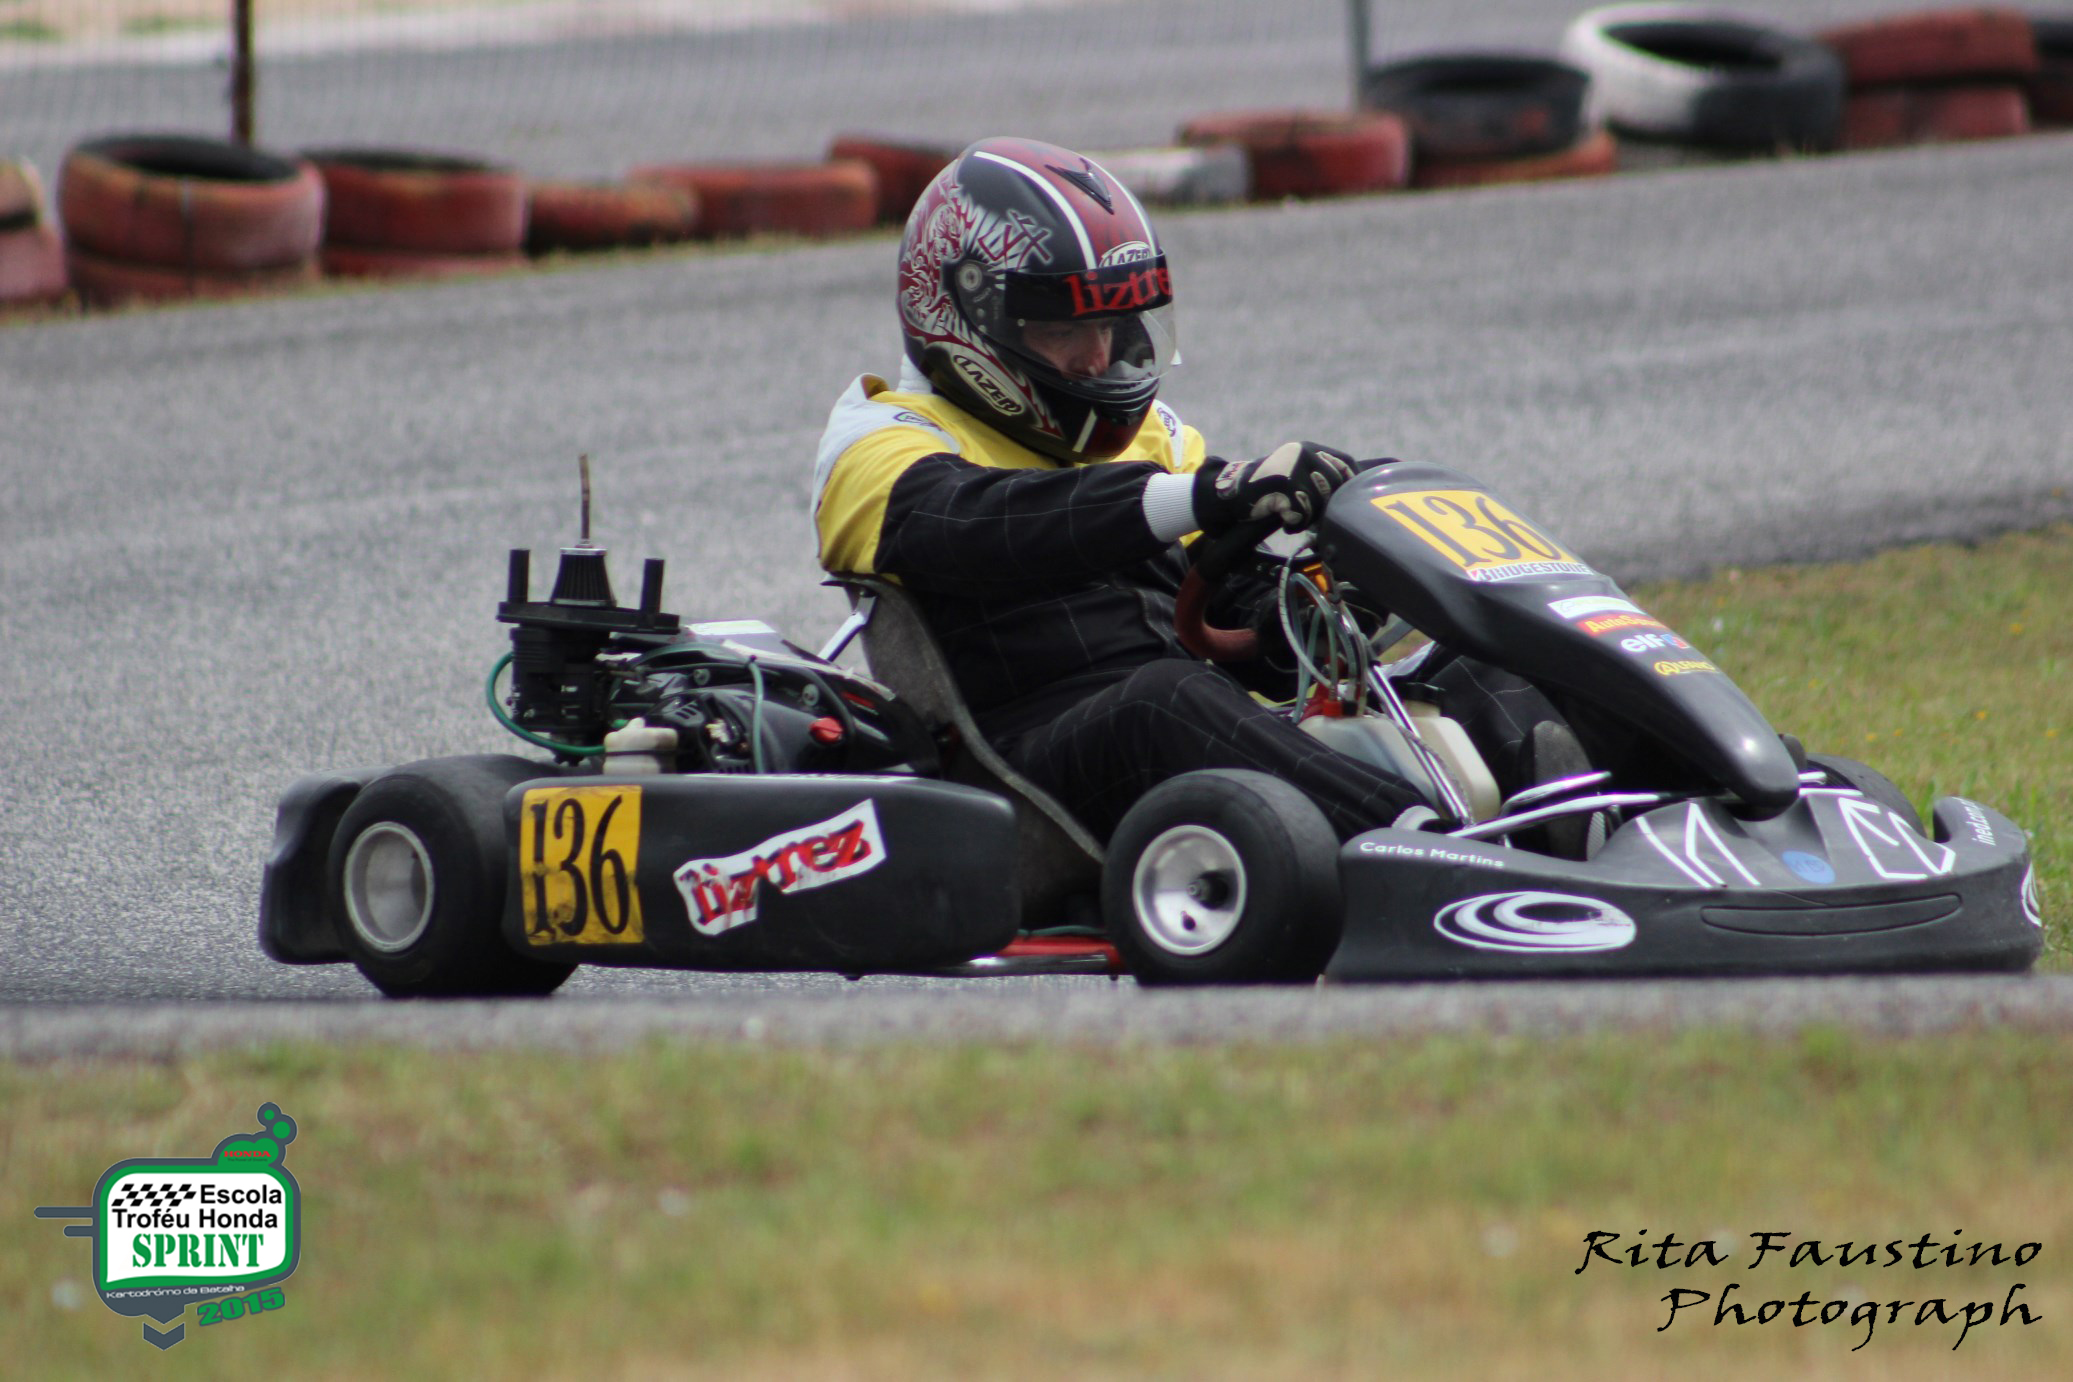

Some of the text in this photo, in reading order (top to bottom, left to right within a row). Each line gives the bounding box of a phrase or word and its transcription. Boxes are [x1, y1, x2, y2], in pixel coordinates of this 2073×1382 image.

[1384, 496, 1562, 567] 136
[1473, 562, 1592, 581] BRIDGESTONE
[1621, 633, 1665, 652] elf
[530, 795, 630, 936] 136
[1360, 842, 1504, 868] Carlos Martins
